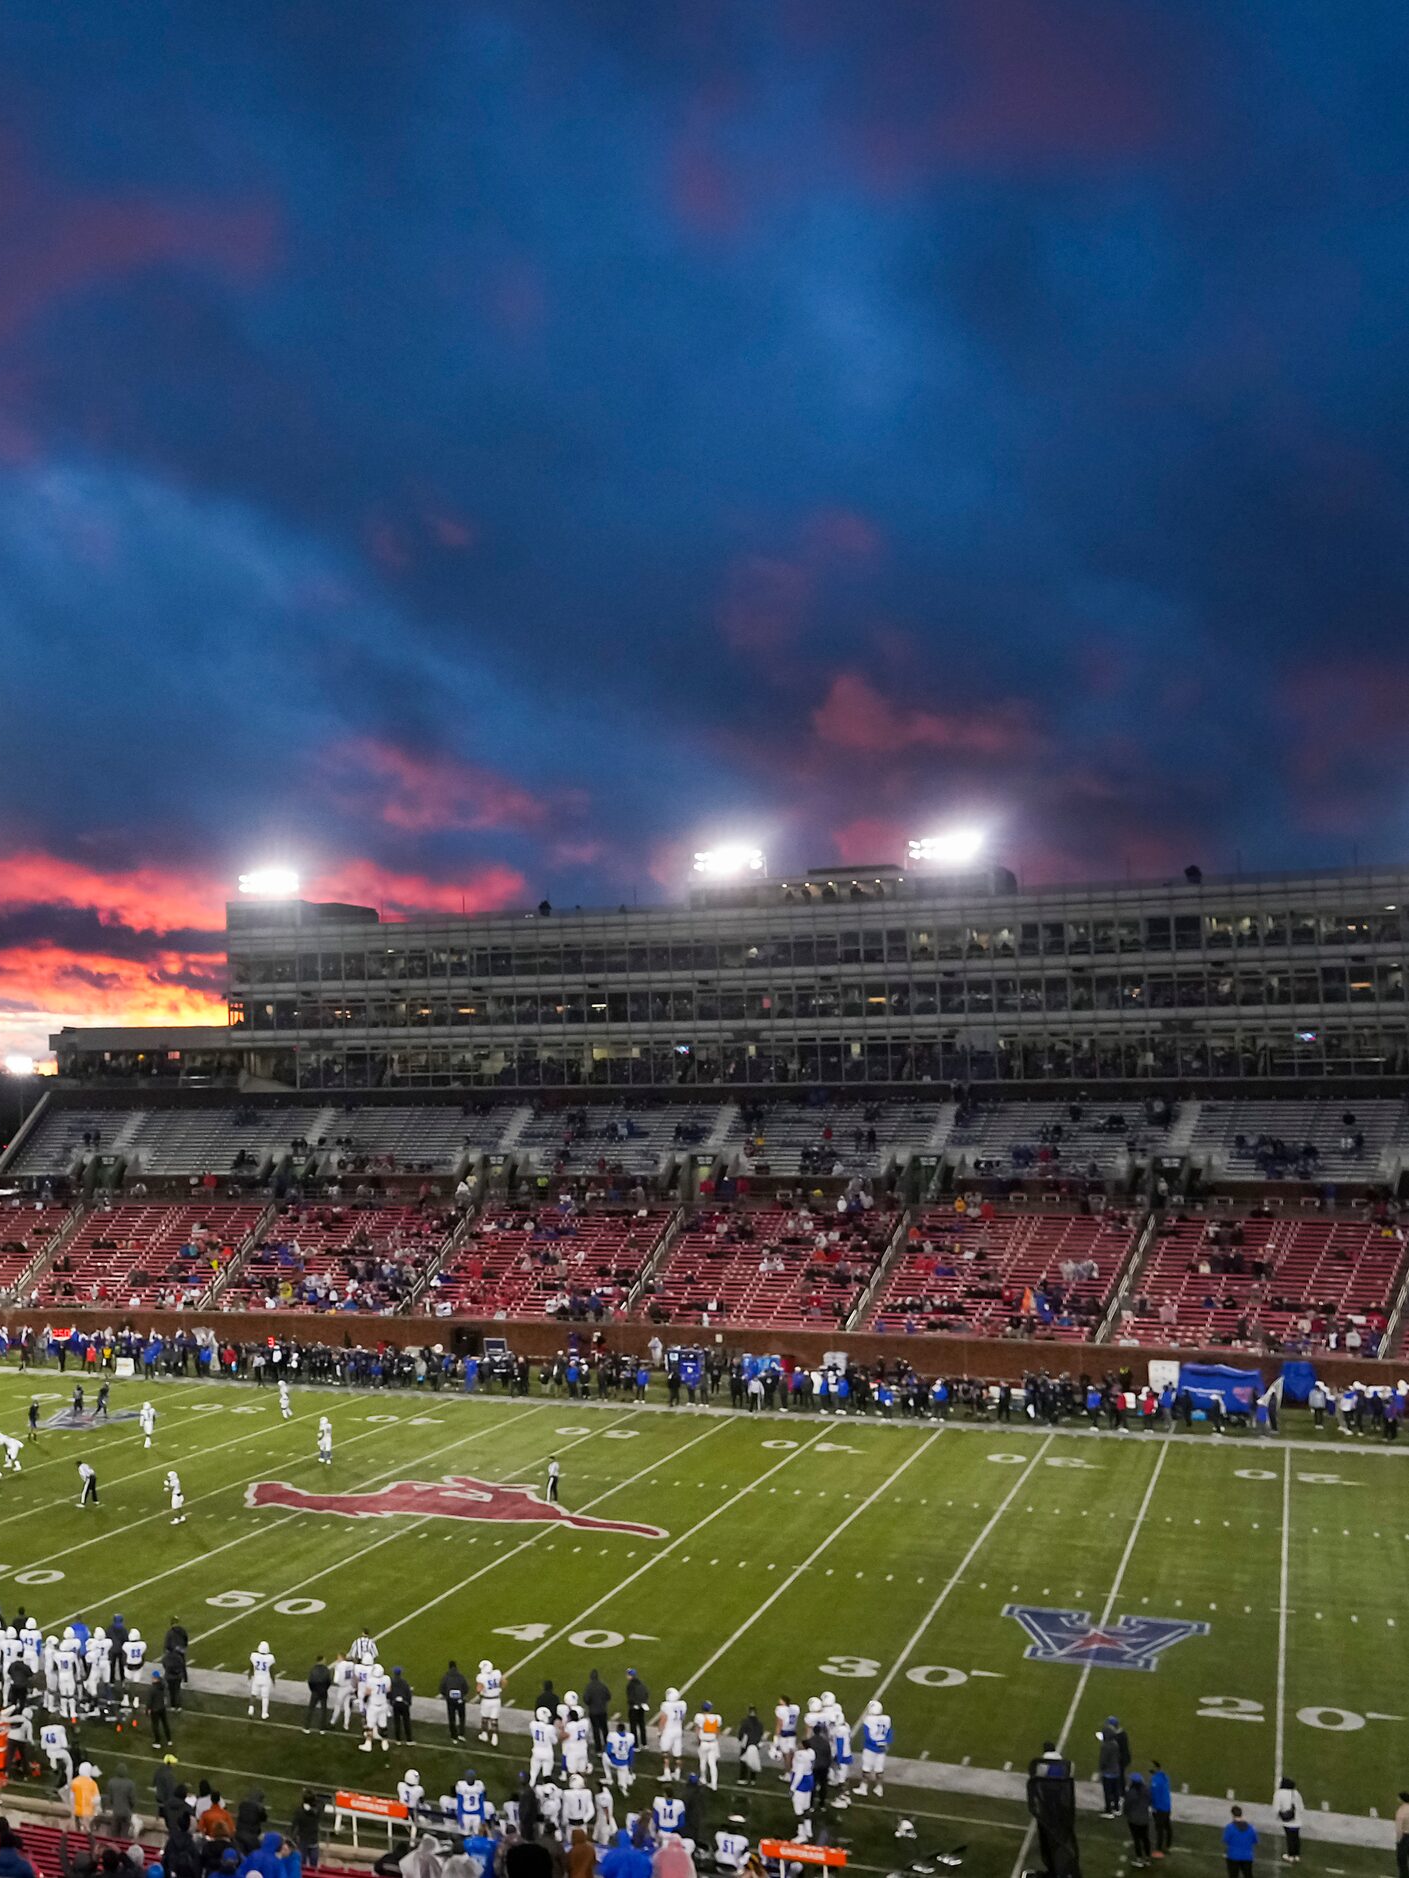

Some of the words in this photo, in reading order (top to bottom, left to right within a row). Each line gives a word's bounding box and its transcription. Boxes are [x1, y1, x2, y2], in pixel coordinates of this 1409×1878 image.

[256, 1661, 267, 1671] 25
[663, 1808, 673, 1820] 14
[723, 1839, 734, 1855] 51
